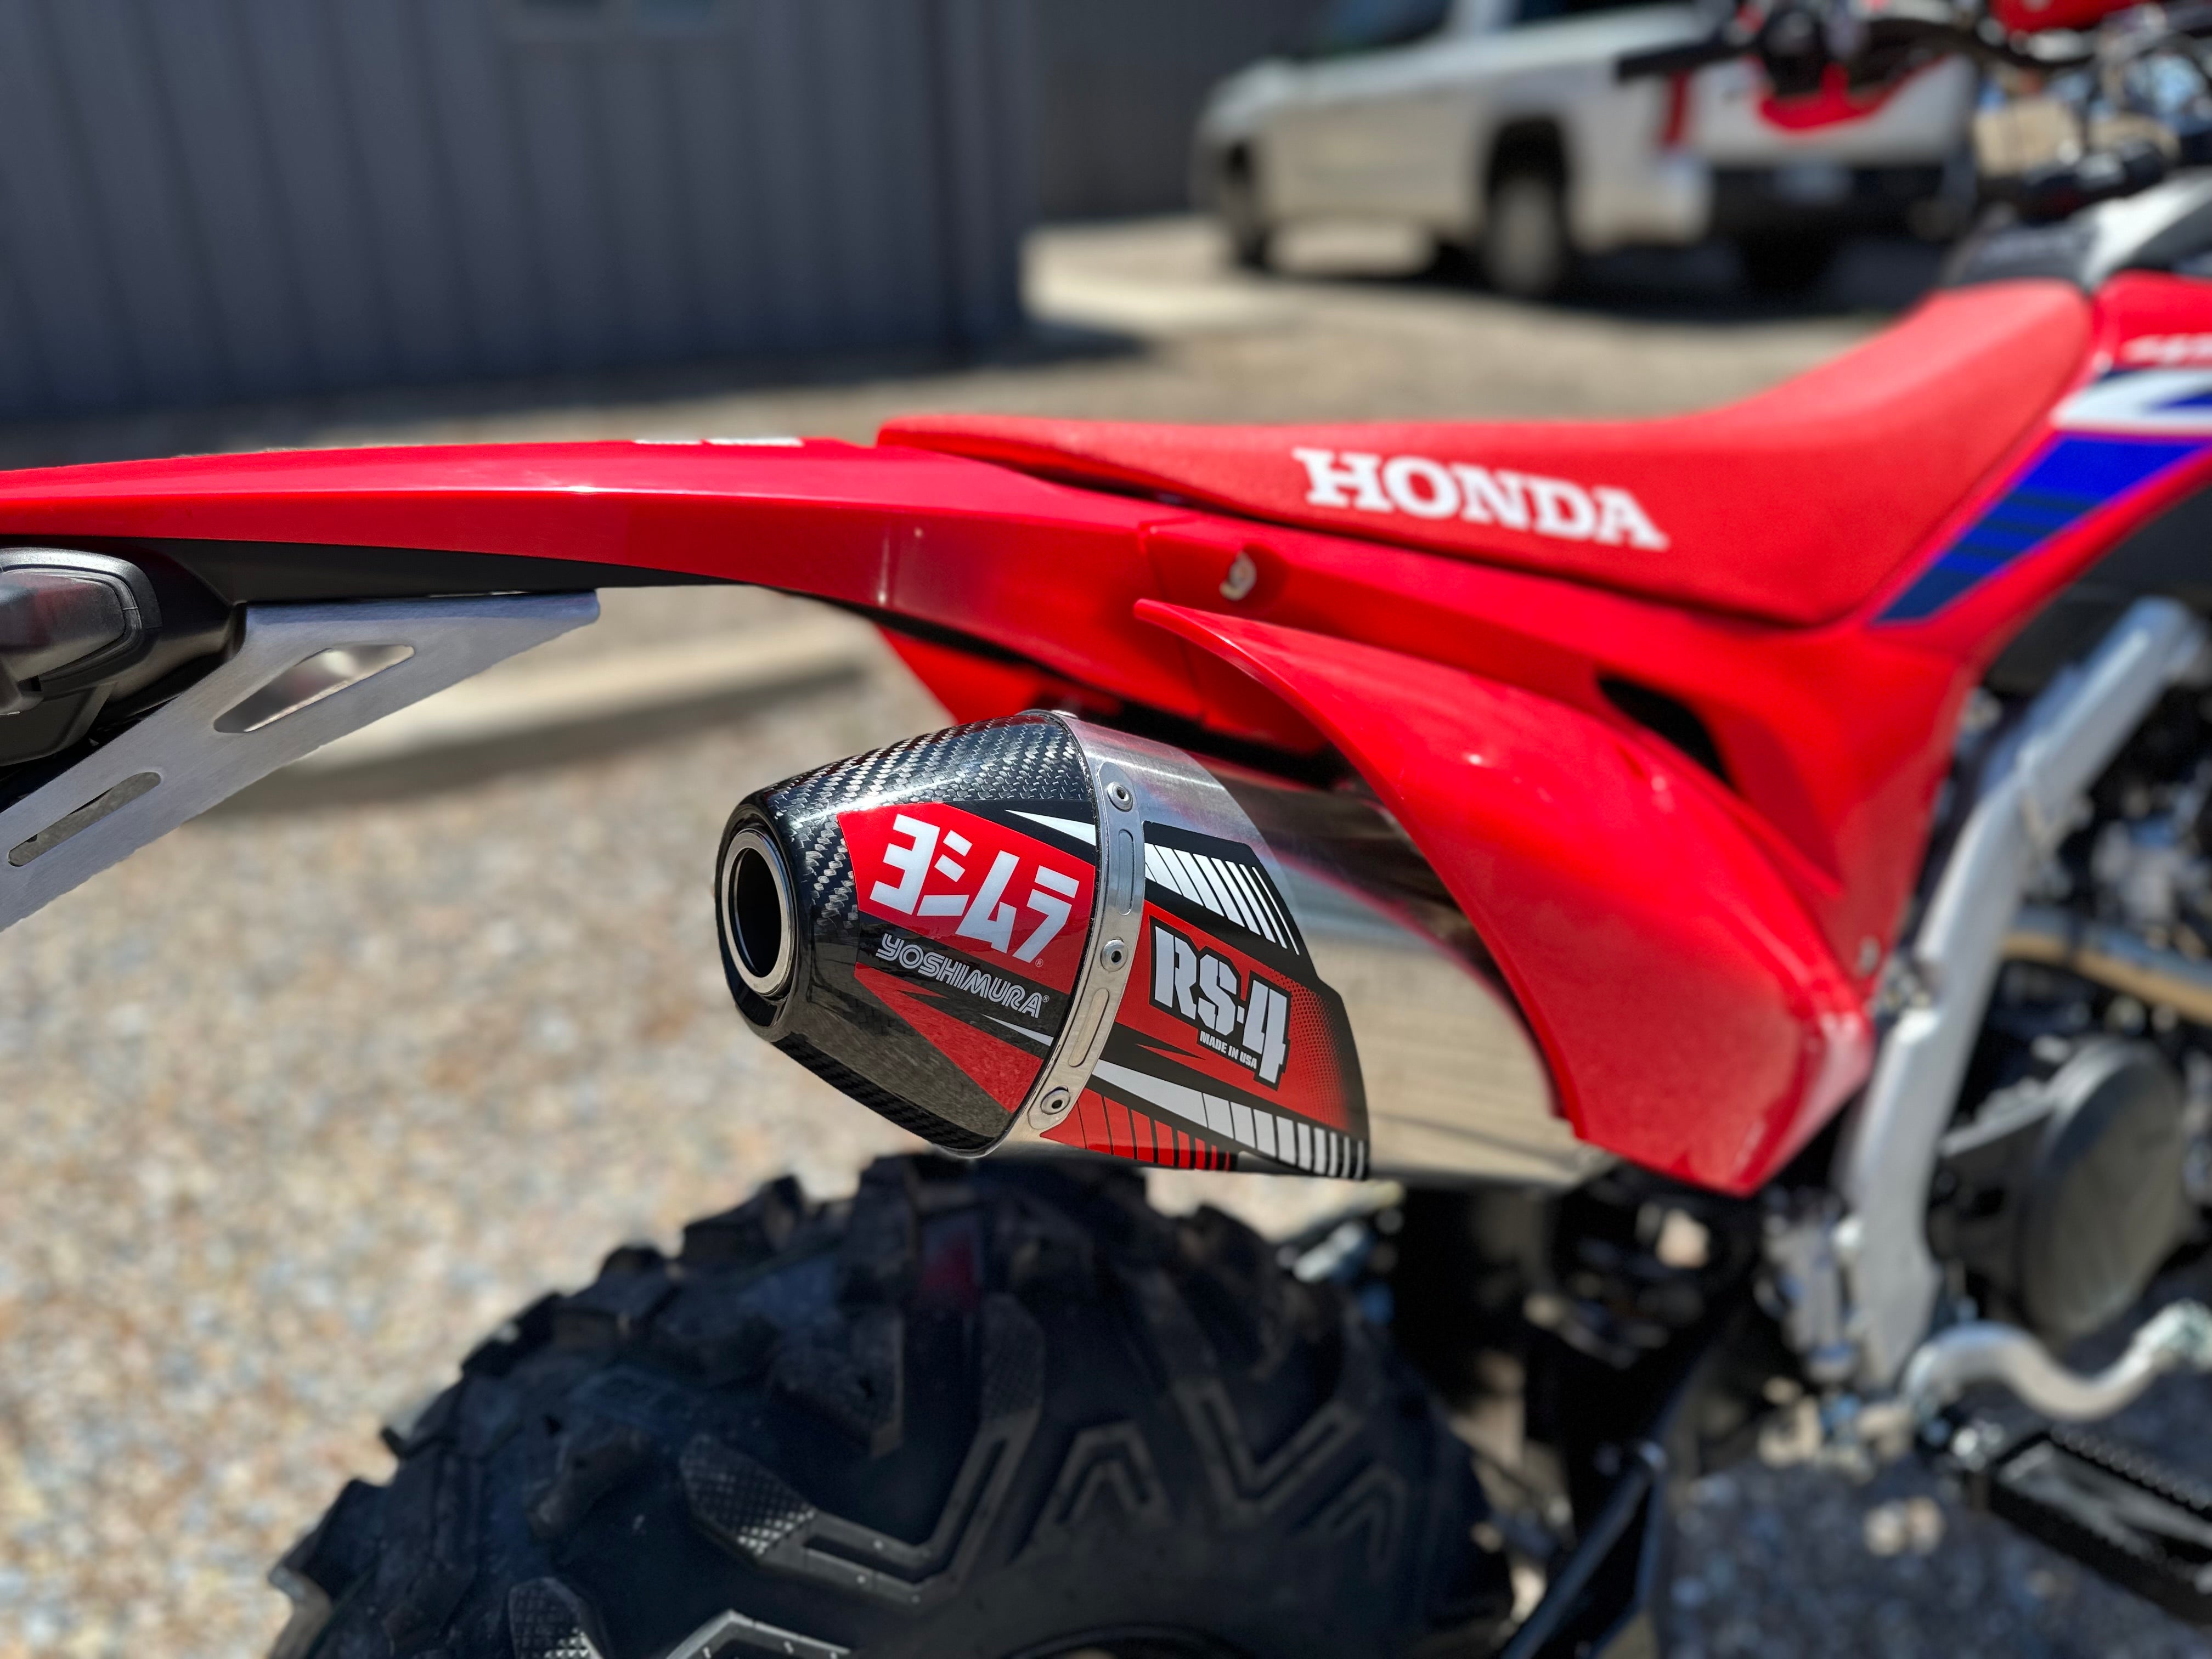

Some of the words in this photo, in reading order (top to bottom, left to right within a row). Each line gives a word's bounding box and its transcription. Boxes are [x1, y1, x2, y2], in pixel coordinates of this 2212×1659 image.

[1292, 447, 1669, 551] HONDA
[870, 814, 1080, 963] ヨシムラ
[876, 933, 1042, 1018] YOSHIMURA
[1200, 1030, 1228, 1054] MADE
[1228, 1045, 1239, 1060] IN
[1239, 1051, 1257, 1069] USA
